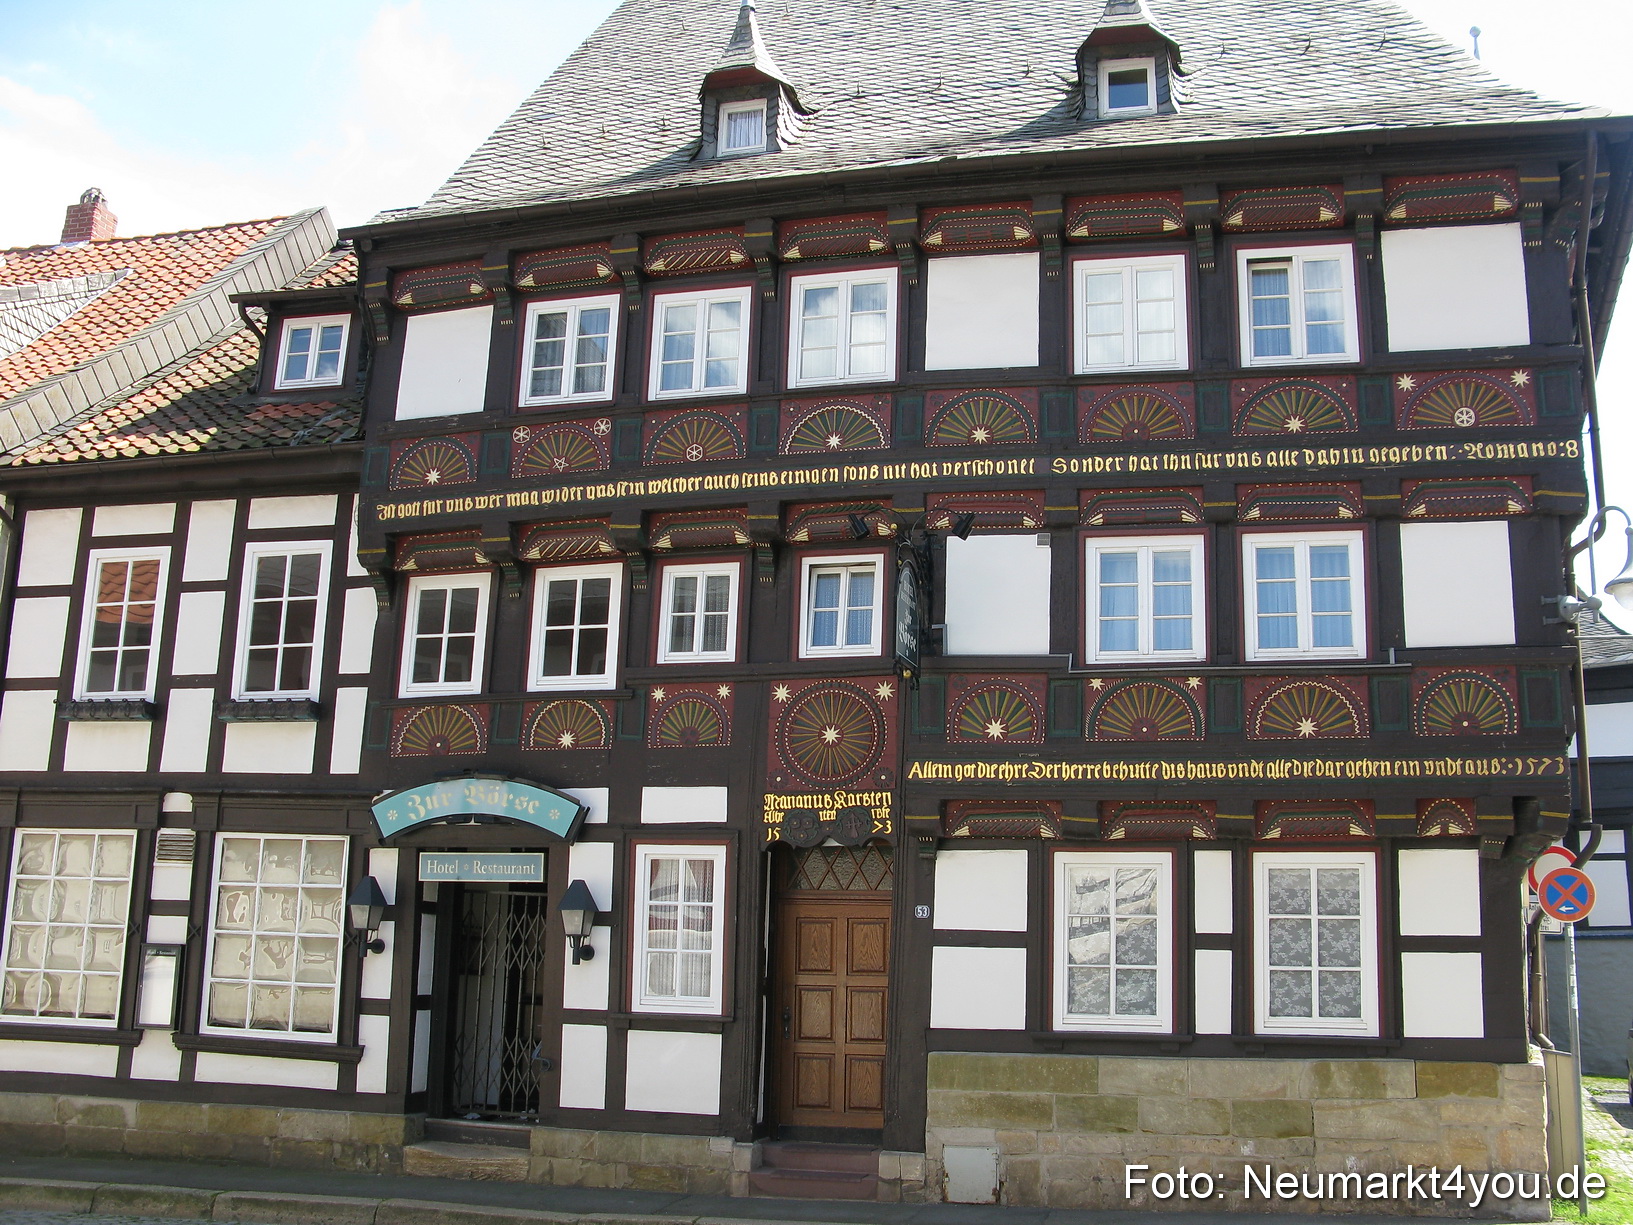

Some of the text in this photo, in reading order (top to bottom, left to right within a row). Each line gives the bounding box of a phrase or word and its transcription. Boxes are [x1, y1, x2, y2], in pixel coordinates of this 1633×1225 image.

[407, 785, 540, 821] Zur Börse
[427, 859, 535, 876] Hotel Restaurant
[917, 906, 928, 917] 53
